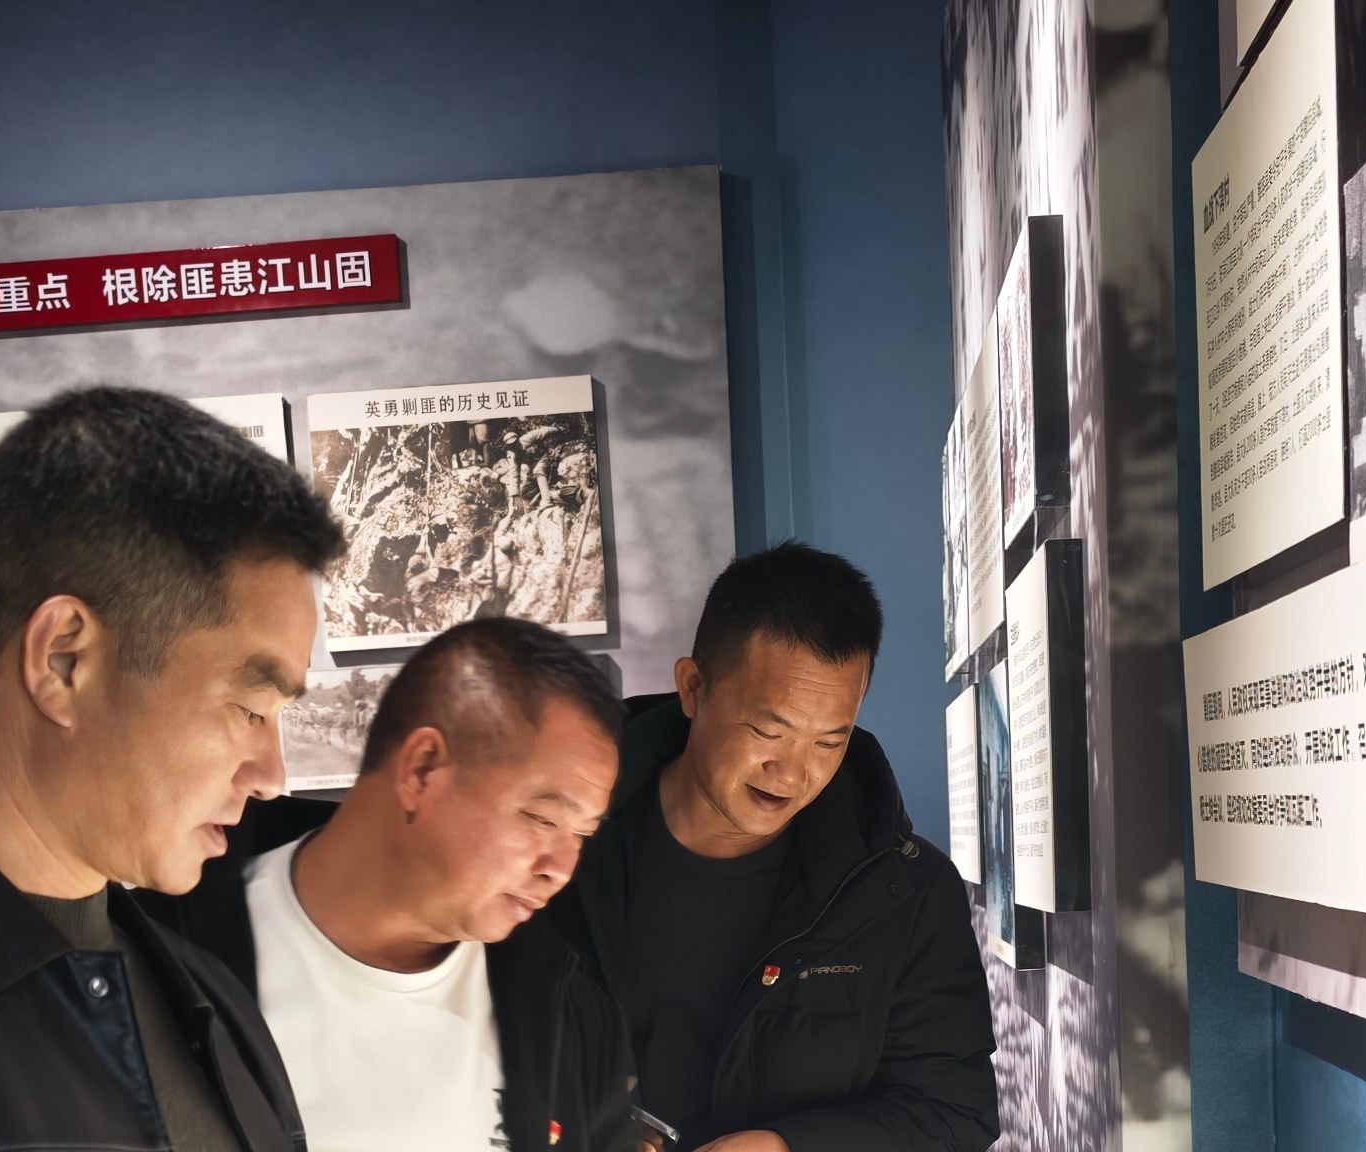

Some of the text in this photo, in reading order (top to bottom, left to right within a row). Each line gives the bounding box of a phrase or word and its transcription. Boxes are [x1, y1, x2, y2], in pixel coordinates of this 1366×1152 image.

[102, 251, 372, 306] 根除匪患江山固
[365, 389, 530, 418] 英勇剿匪的历史见证
